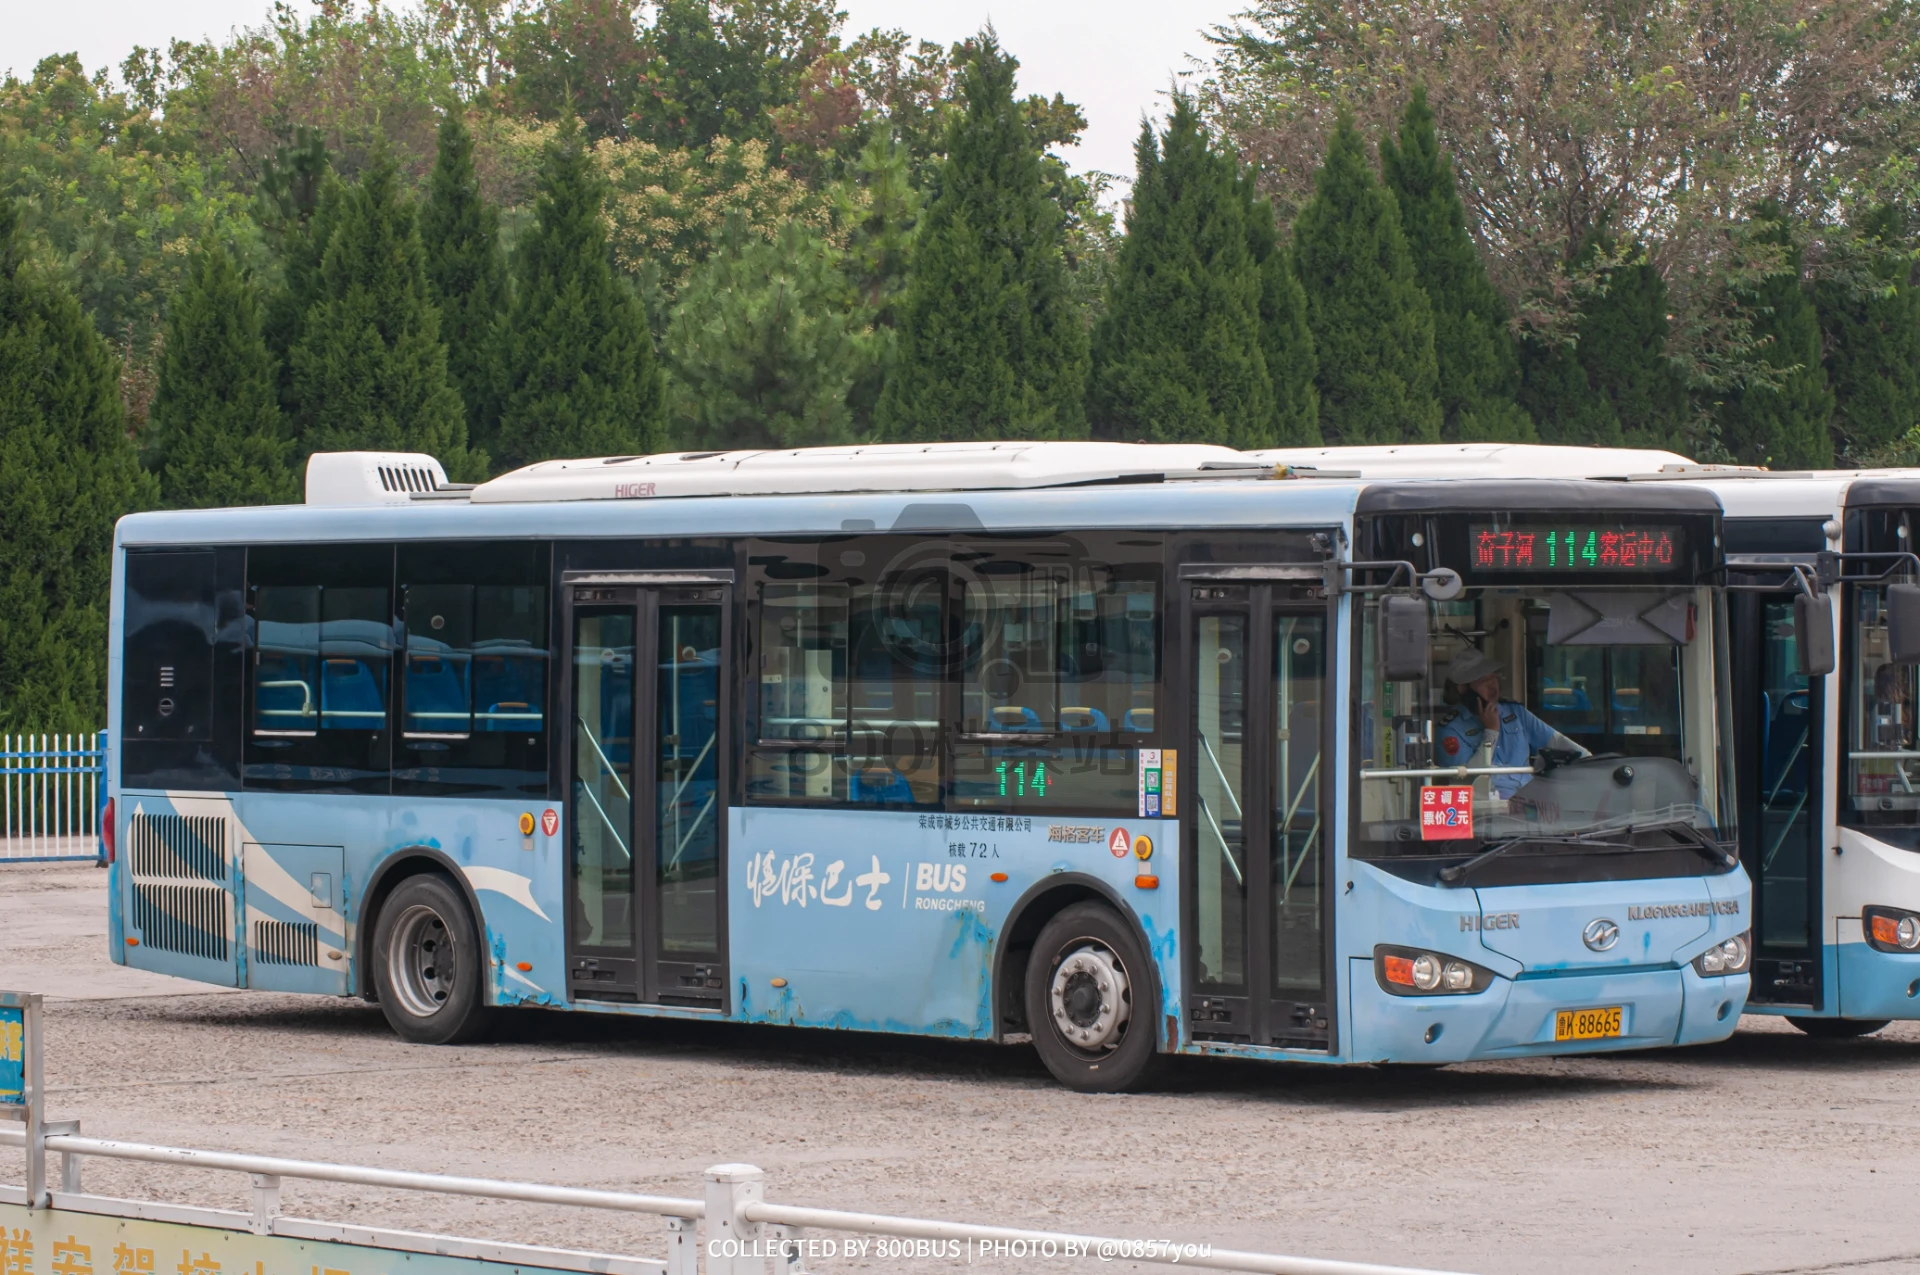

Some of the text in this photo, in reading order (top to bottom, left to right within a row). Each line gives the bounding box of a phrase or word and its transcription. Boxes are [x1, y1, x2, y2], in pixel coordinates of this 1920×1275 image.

[615, 483, 656, 497] HIGER
[1546, 531, 1598, 566] 114
[1600, 531, 1673, 566] 客运中心
[995, 761, 1046, 797] 114
[1423, 790, 1469, 805] 空调车
[918, 814, 1032, 833] 荣成市城乡公共交通有限公司
[1423, 807, 1469, 826] 票价2元
[1047, 824, 1106, 844] 海格客车
[916, 862, 967, 893] BUS
[915, 897, 986, 913] RONGCHENG
[1460, 913, 1520, 932] HIGER
